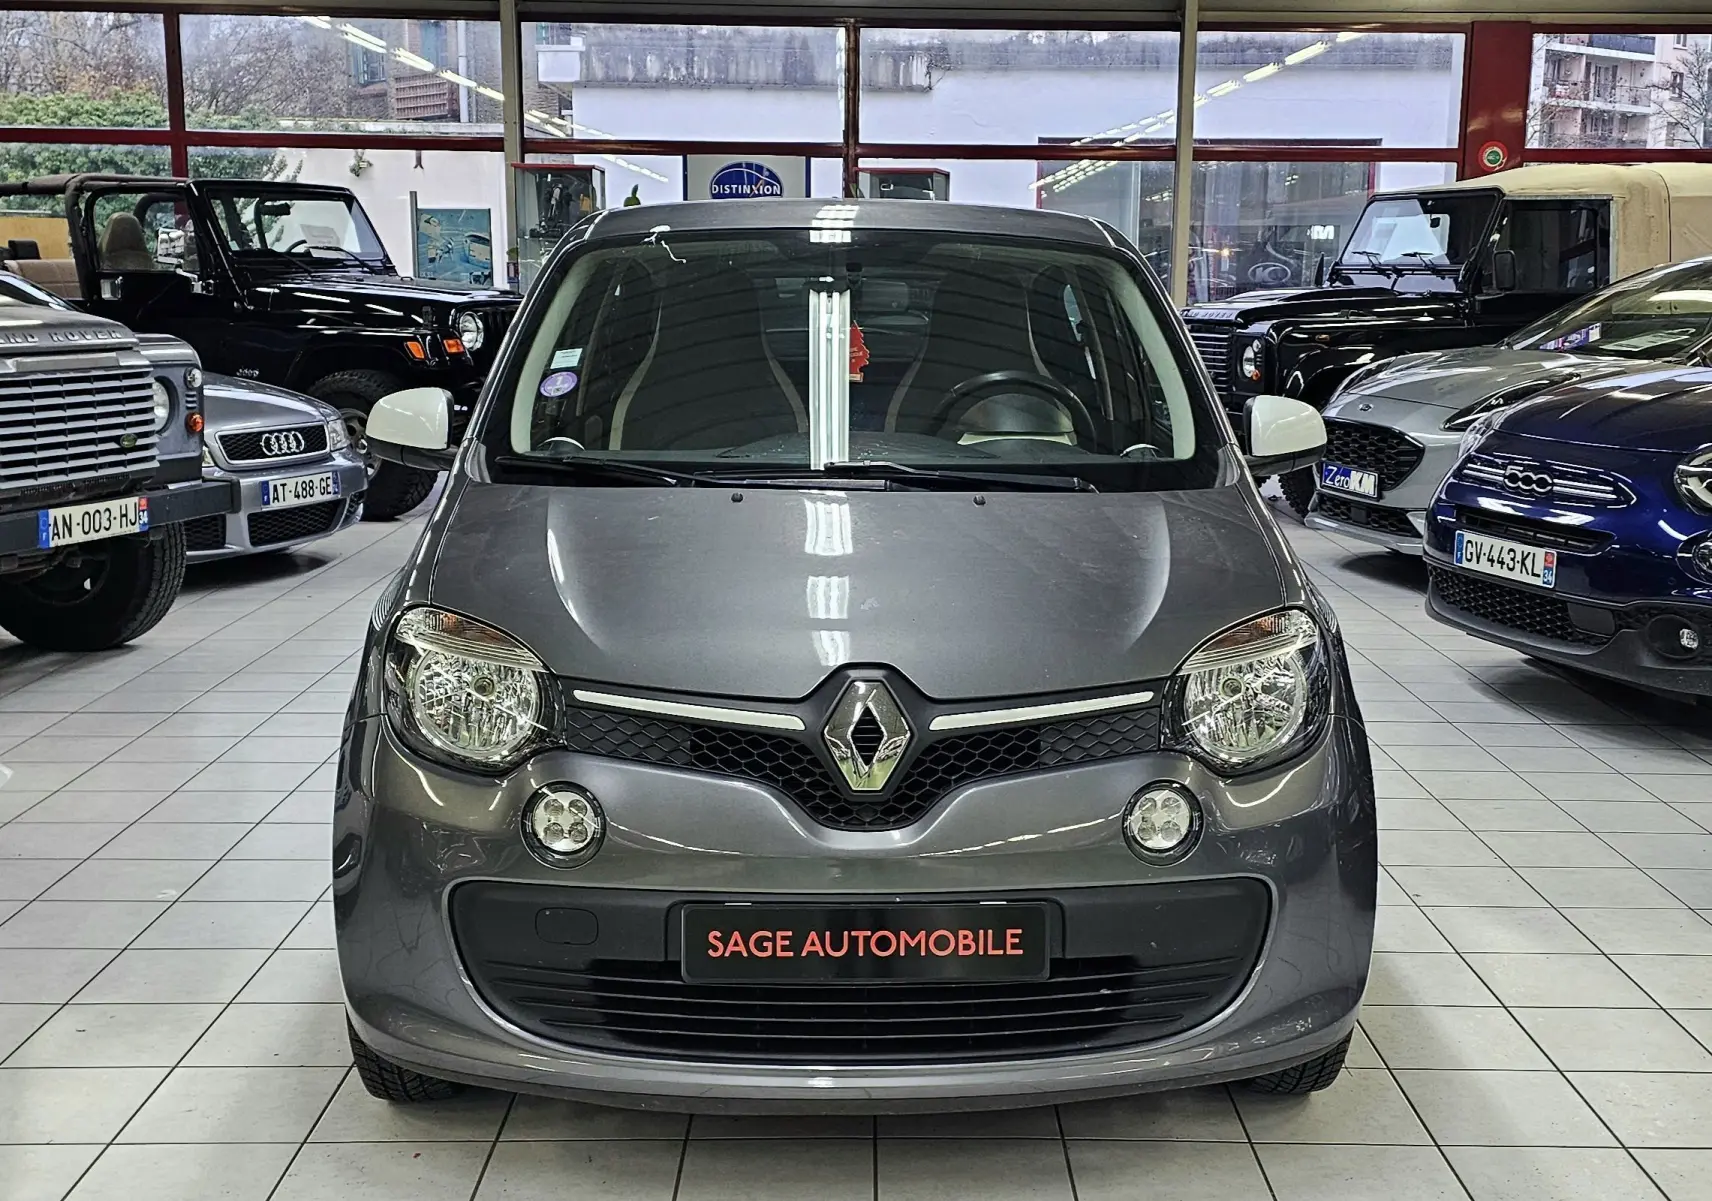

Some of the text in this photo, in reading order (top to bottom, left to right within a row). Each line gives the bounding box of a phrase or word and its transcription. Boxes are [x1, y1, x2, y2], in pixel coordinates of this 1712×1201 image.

[711, 182, 781, 196] DISTINXION
[0, 330, 122, 344] ND ROVER
[707, 928, 1024, 958] SAGE AUTOMOBILE
